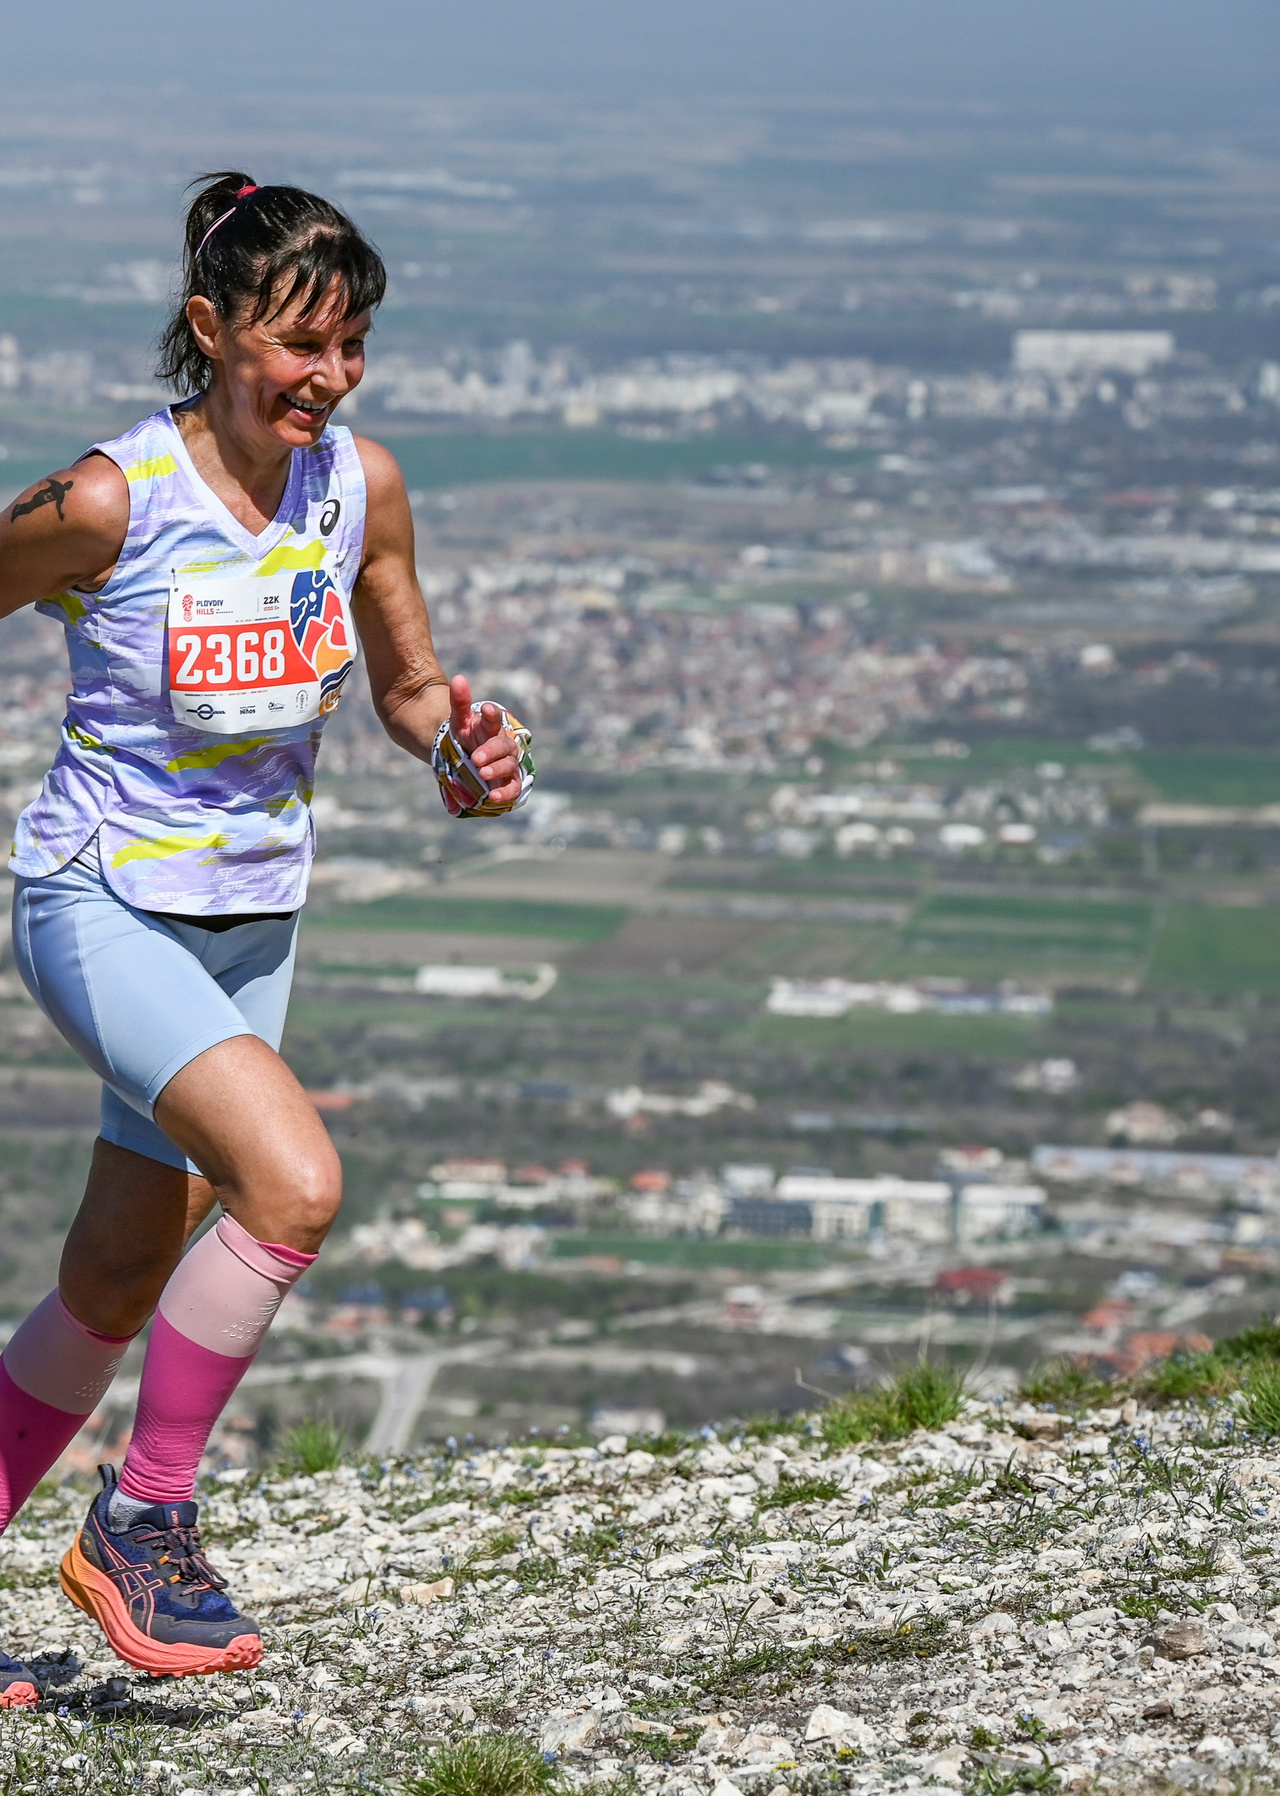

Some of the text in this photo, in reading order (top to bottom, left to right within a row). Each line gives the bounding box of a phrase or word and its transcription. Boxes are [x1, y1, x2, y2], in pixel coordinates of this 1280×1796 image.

[196, 599, 224, 607] PLOVDIV
[263, 595, 280, 605] 22K
[176, 628, 285, 685] 2368
